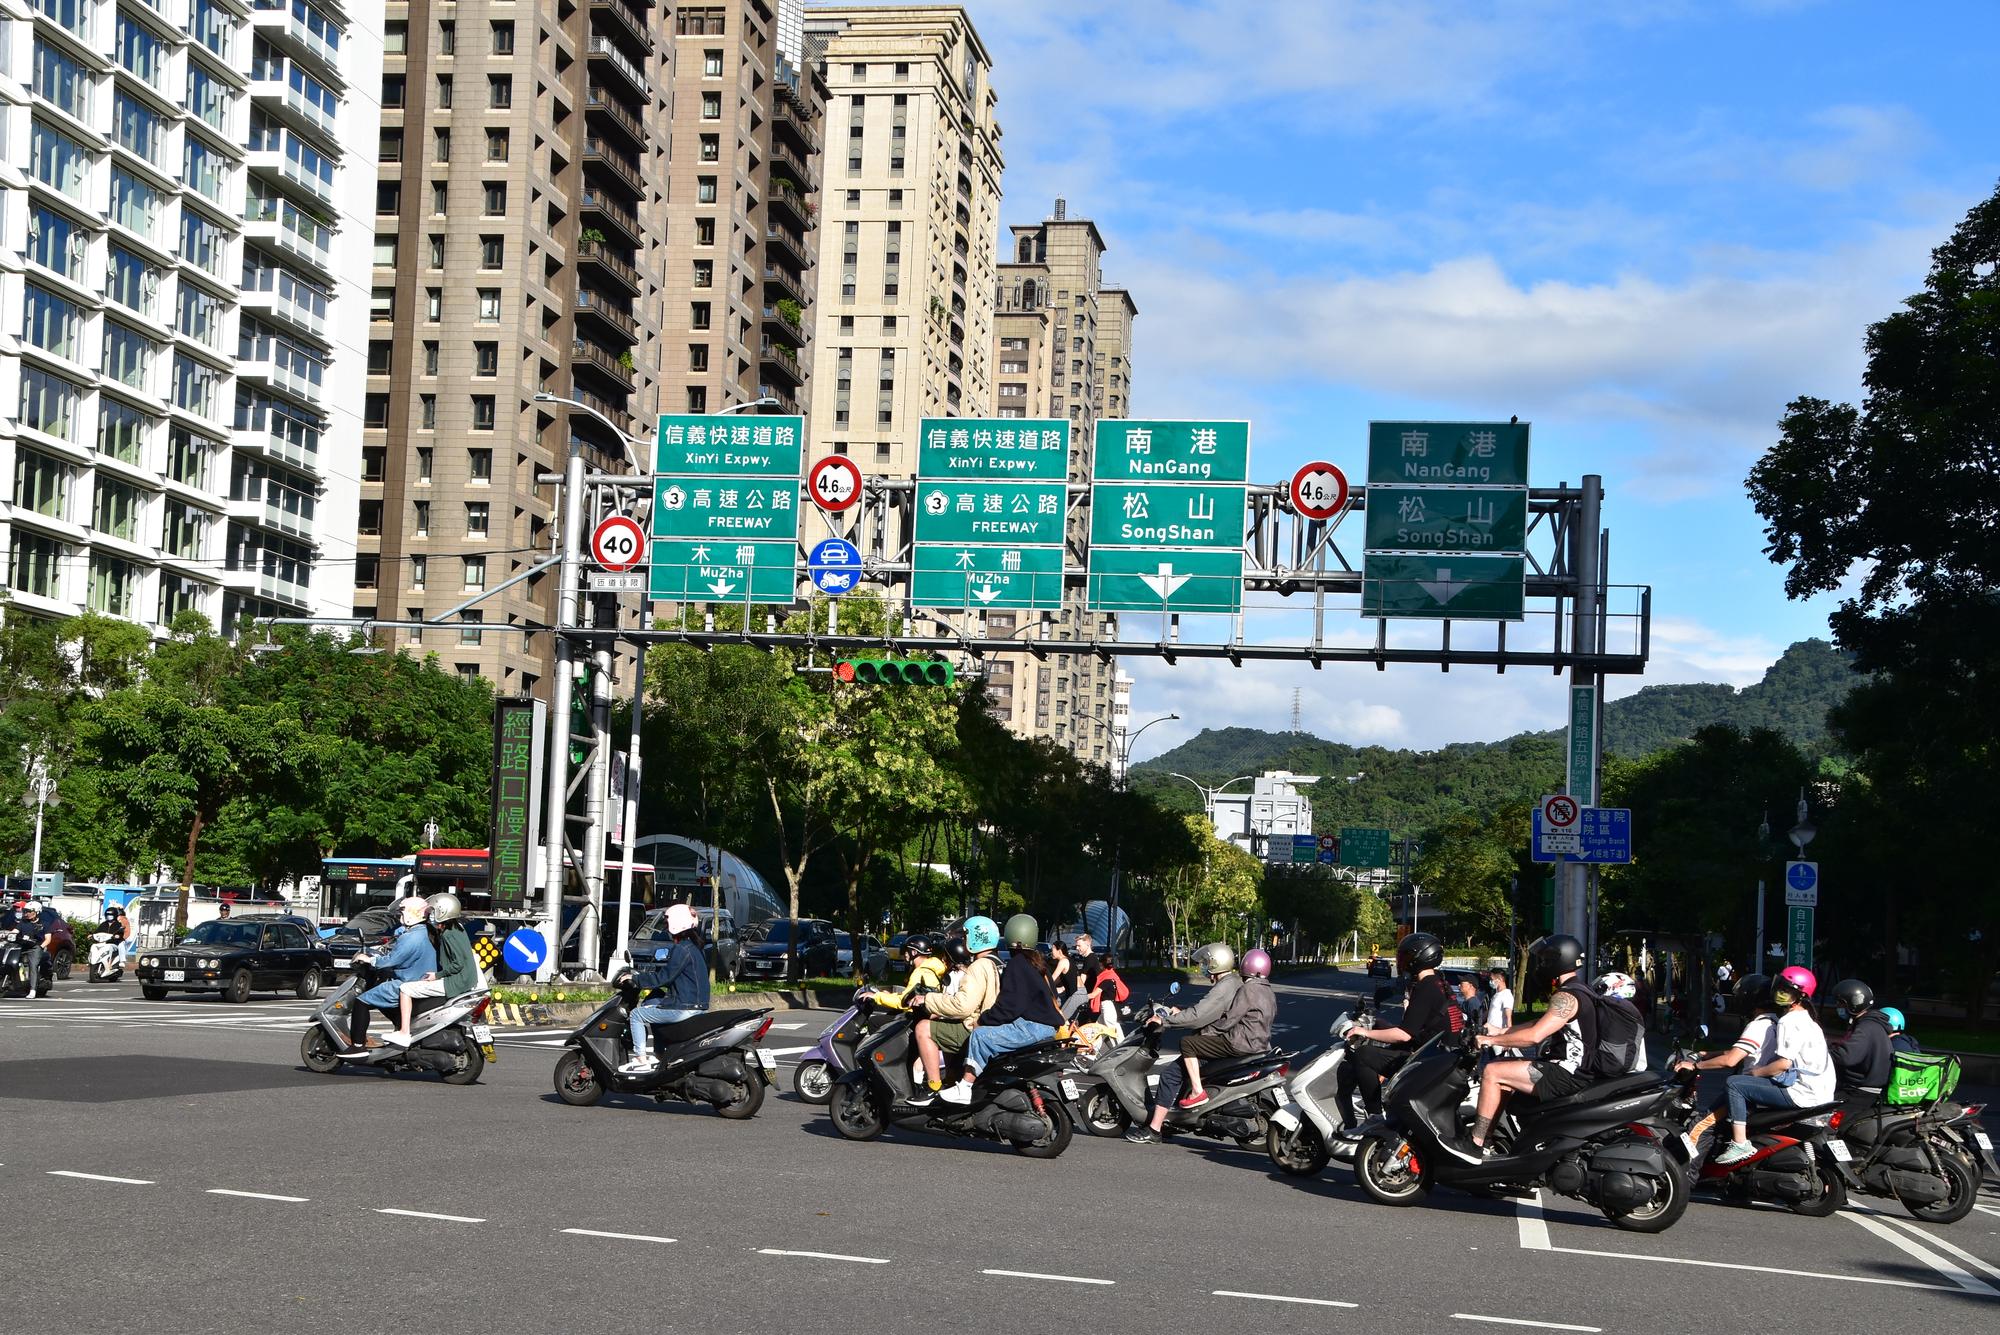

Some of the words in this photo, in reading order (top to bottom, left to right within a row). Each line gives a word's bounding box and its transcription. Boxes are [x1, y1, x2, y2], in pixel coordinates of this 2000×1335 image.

[665, 425, 795, 447] 信義快速道路
[927, 429, 1061, 451] 信義快速道路
[1125, 428, 1217, 455] 南港
[1400, 430, 1496, 458] 南港
[685, 452, 719, 464] XinYi
[724, 453, 771, 467] Expwy.
[948, 456, 983, 468] XinYi
[989, 457, 1037, 472] Expwy.
[1129, 460, 1211, 479] NanGang
[1405, 462, 1490, 481] NanGang
[670, 492, 679, 505] 3
[692, 488, 792, 510] 高速公路
[933, 497, 942, 510] 3
[956, 493, 1059, 515] 高速公路
[1123, 492, 1214, 521] 松山
[1398, 496, 1494, 525] 松山
[708, 516, 773, 529] FREEWAY
[972, 521, 1039, 534] FREEWAY
[1121, 524, 1214, 543] SongShan
[1397, 529, 1494, 547] SongShan
[603, 536, 633, 554] 40
[691, 544, 755, 565] 木柵
[955, 550, 1021, 571] 木柵
[700, 567, 744, 579] MuZha
[966, 573, 1010, 585] MuZha
[1575, 699, 1589, 767] 信義路五段
[1899, 1077, 1928, 1086] Uber
[1899, 1087, 1929, 1097] Eats
